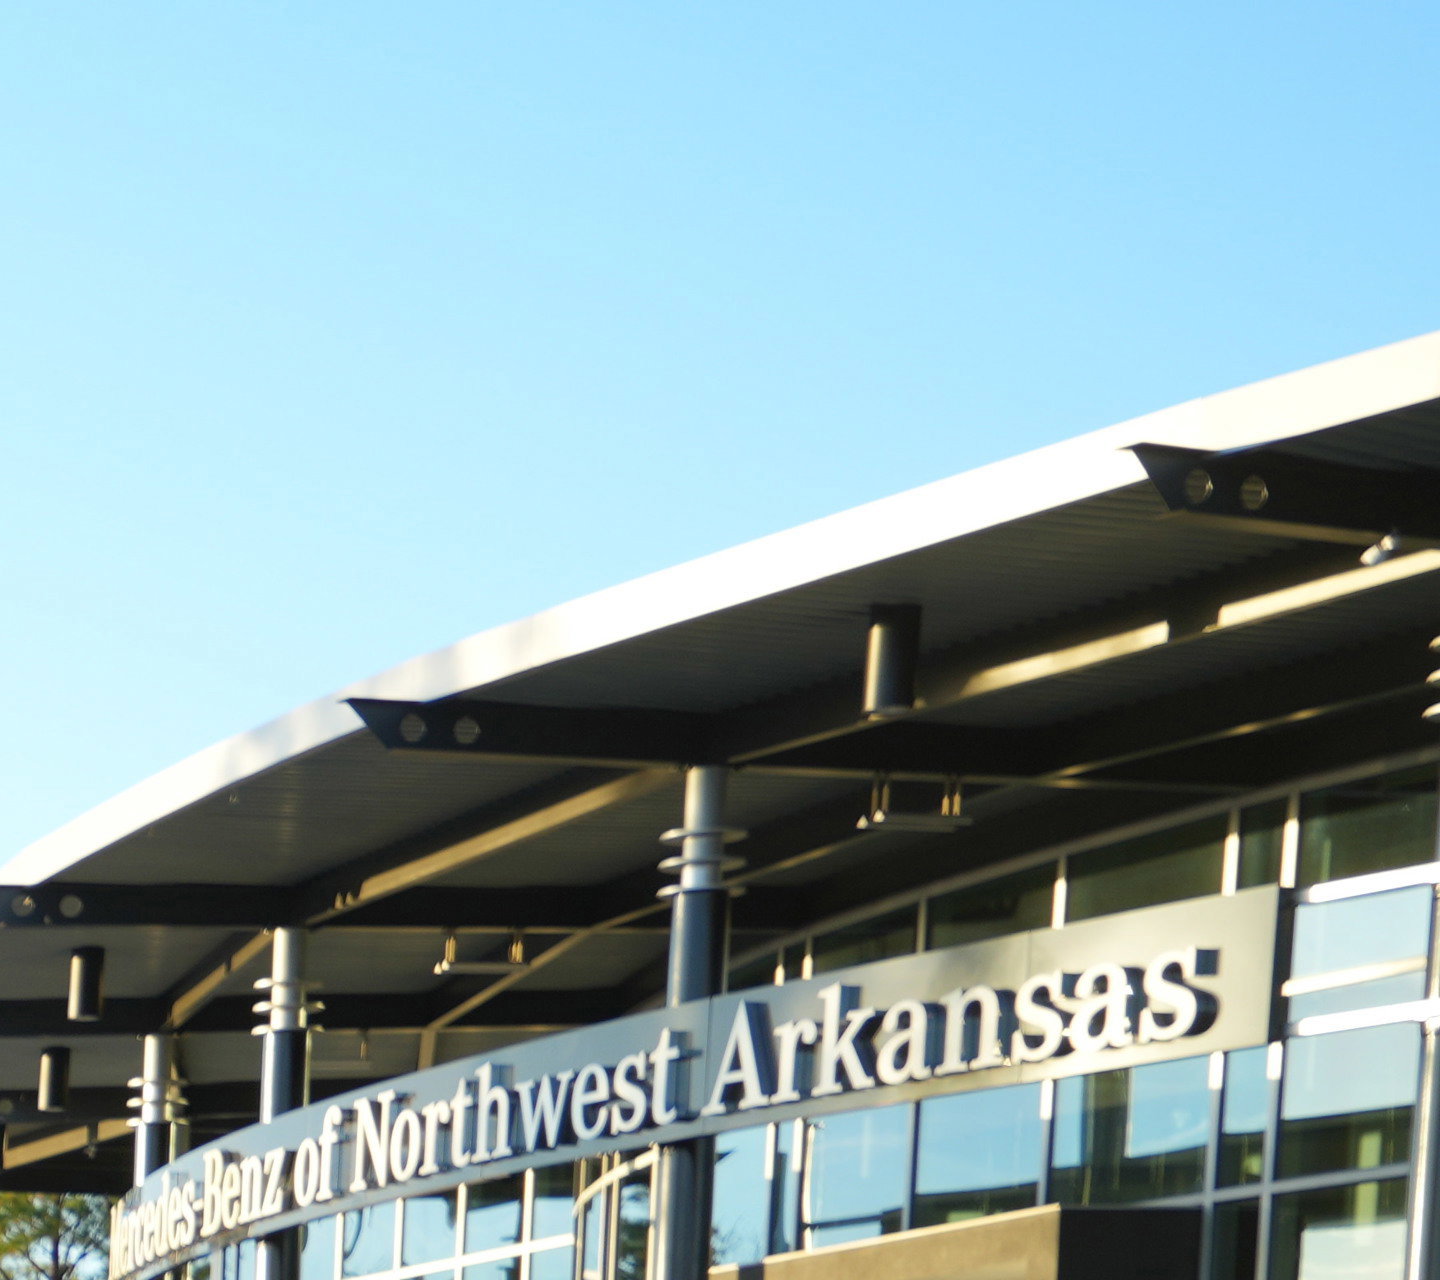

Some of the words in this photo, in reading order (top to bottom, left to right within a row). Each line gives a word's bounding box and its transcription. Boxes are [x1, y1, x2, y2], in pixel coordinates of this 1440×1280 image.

[293, 1105, 343, 1207] of
[349, 1027, 680, 1193] Northwest
[700, 946, 1197, 1117] Arkansas
